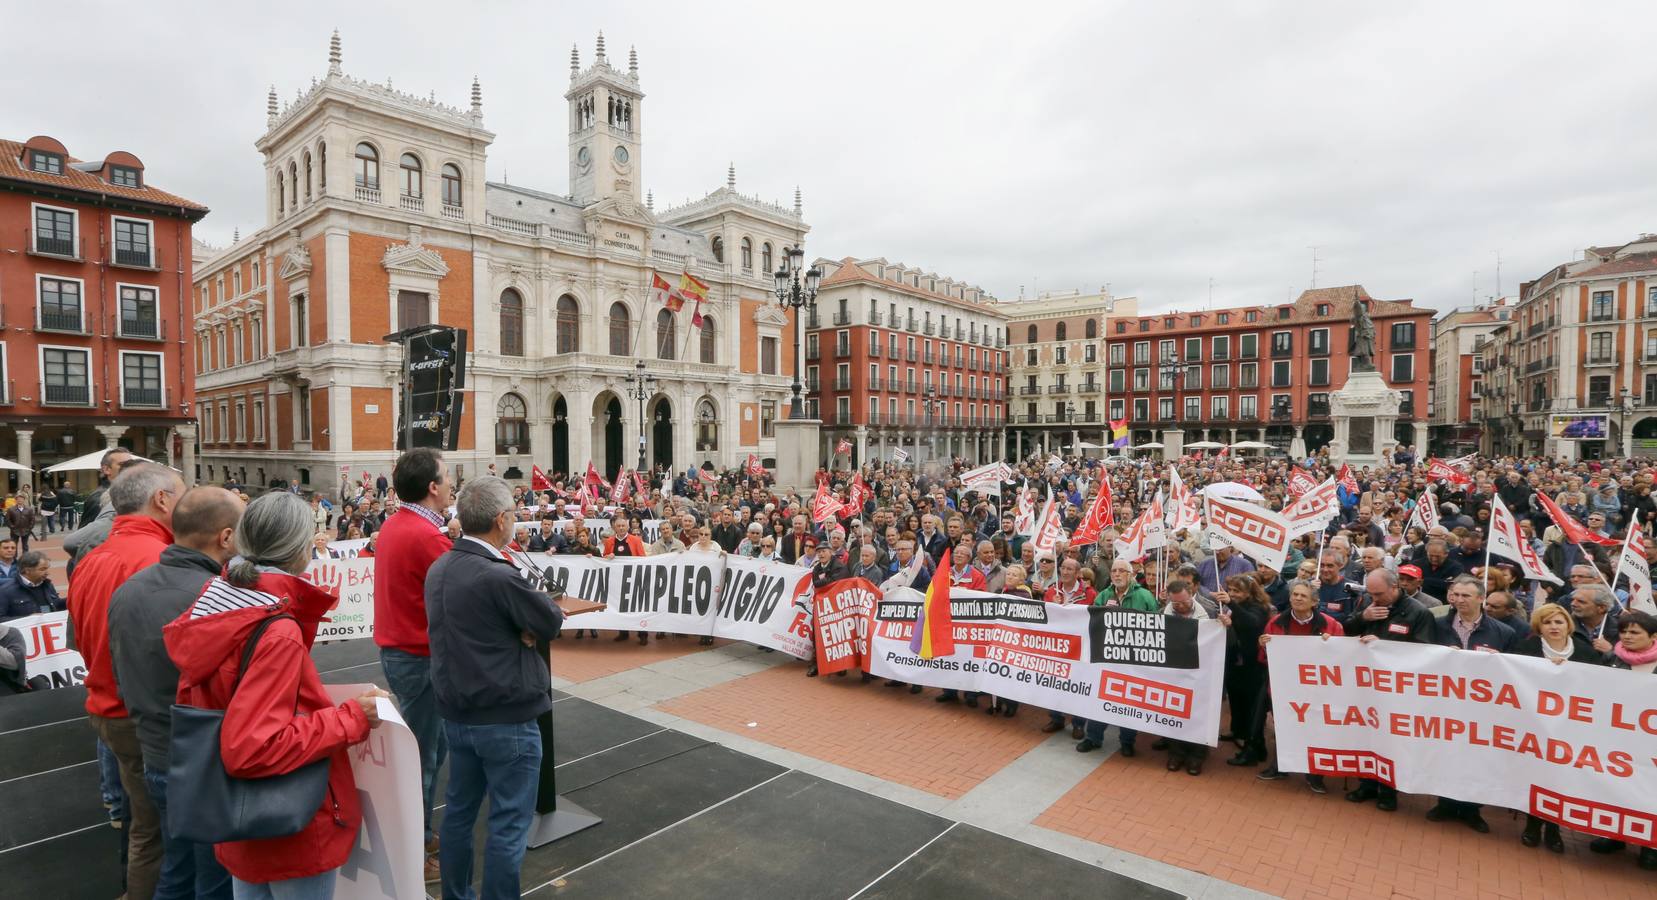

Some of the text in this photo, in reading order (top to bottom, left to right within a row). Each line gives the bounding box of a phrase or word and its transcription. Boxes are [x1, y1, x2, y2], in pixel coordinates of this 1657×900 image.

[616, 231, 631, 240] CASA
[1211, 504, 1281, 545] CCOO
[619, 564, 712, 617] EMPLEO
[717, 567, 785, 625] DIGNO
[817, 597, 834, 617] LA
[880, 605, 905, 618] EMPLEO
[907, 605, 917, 618] DE
[983, 601, 994, 616] DE
[1007, 602, 1045, 619] PENSIONES
[1103, 611, 1166, 630] QUIEREN
[825, 641, 853, 662] PARA
[885, 622, 902, 637] NO
[952, 626, 967, 640] LOS
[970, 628, 1020, 646] SERCIOS
[1021, 634, 1070, 653] SOCIALES
[1103, 629, 1166, 648] ACABAR
[986, 646, 1069, 677] AS PENSIONES
[1103, 646, 1166, 664] CON TODO
[886, 651, 959, 671] Pensionistas
[963, 660, 980, 673] de
[1016, 670, 1032, 683] de
[1036, 673, 1092, 696] Valladolid
[1104, 677, 1187, 713] CCOO
[1298, 663, 1343, 687] EN
[1355, 665, 1521, 710] DEFENSA
[1537, 689, 1595, 724] DE
[1103, 702, 1183, 728] Castilla y León
[1288, 701, 1311, 723] Y
[1323, 703, 1380, 730] LAS
[1389, 712, 1633, 778] EMPLEADAS
[1312, 751, 1393, 783] CCOO
[1535, 790, 1653, 842] CCOO
